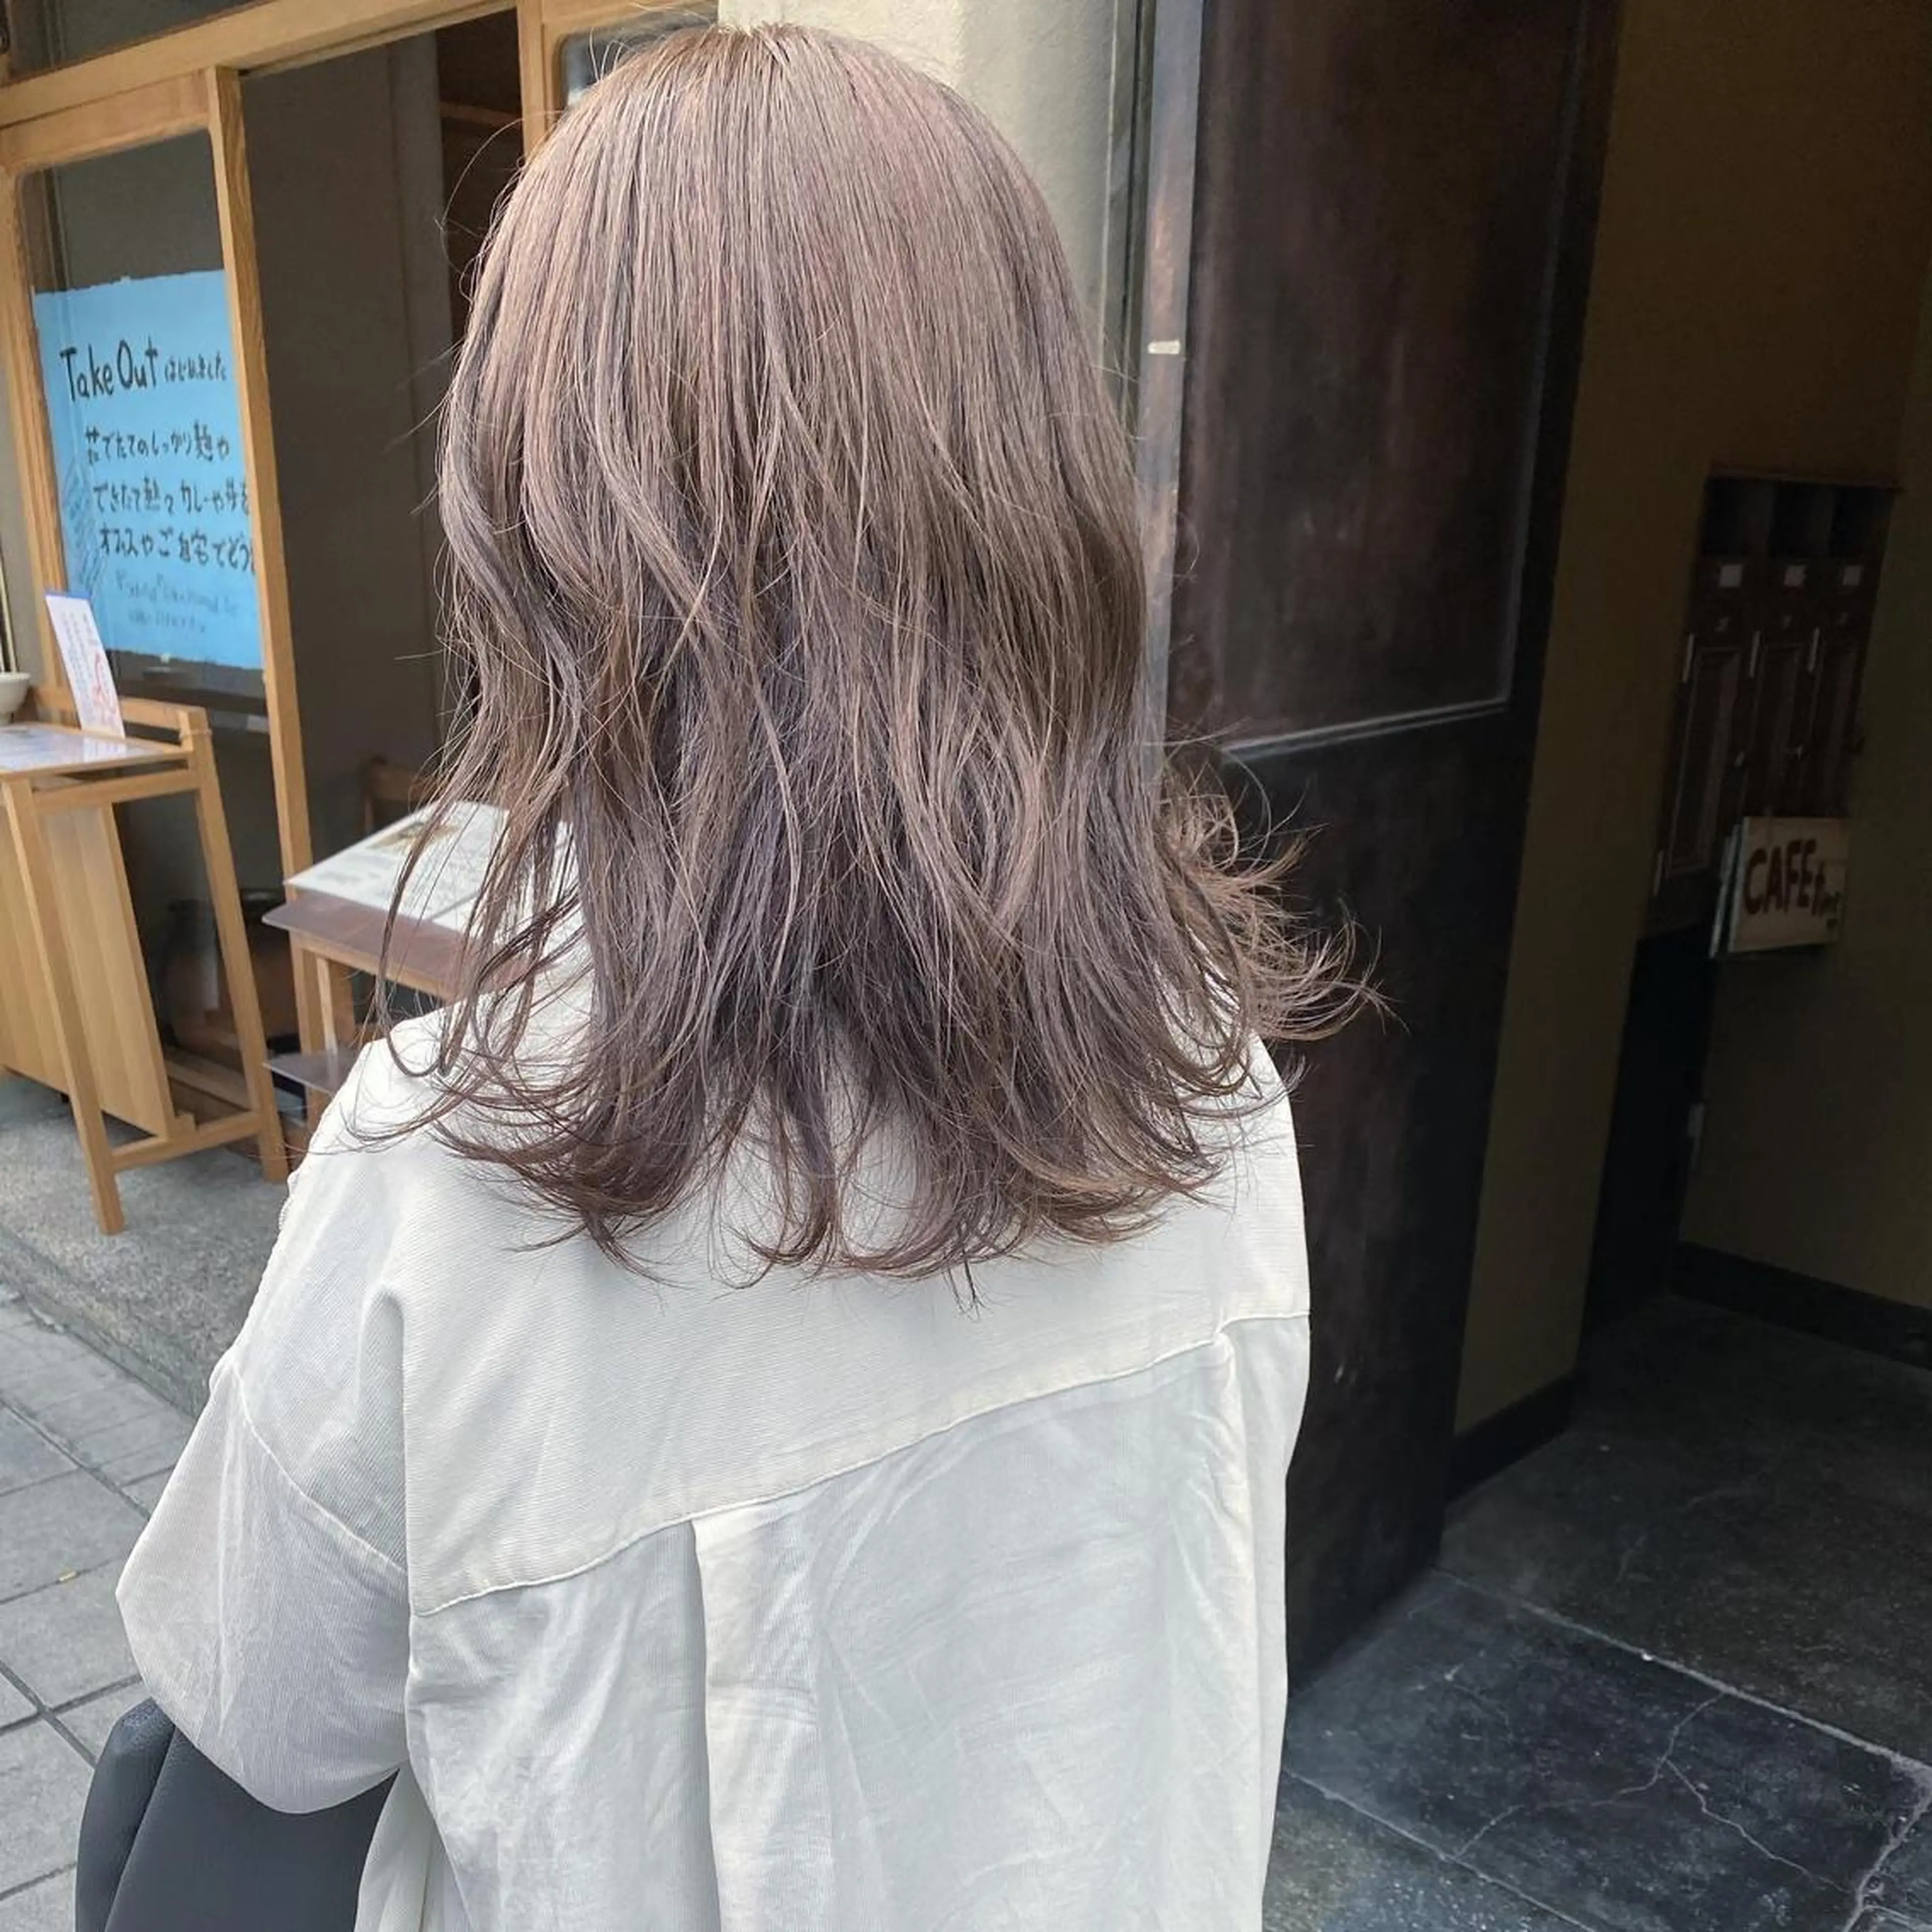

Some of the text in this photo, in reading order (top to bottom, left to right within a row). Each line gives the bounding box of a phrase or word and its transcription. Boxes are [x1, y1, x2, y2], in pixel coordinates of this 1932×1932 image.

[60, 344, 115, 401] Take
[117, 336, 159, 390] Out
[1743, 838, 1817, 915] CAFE
